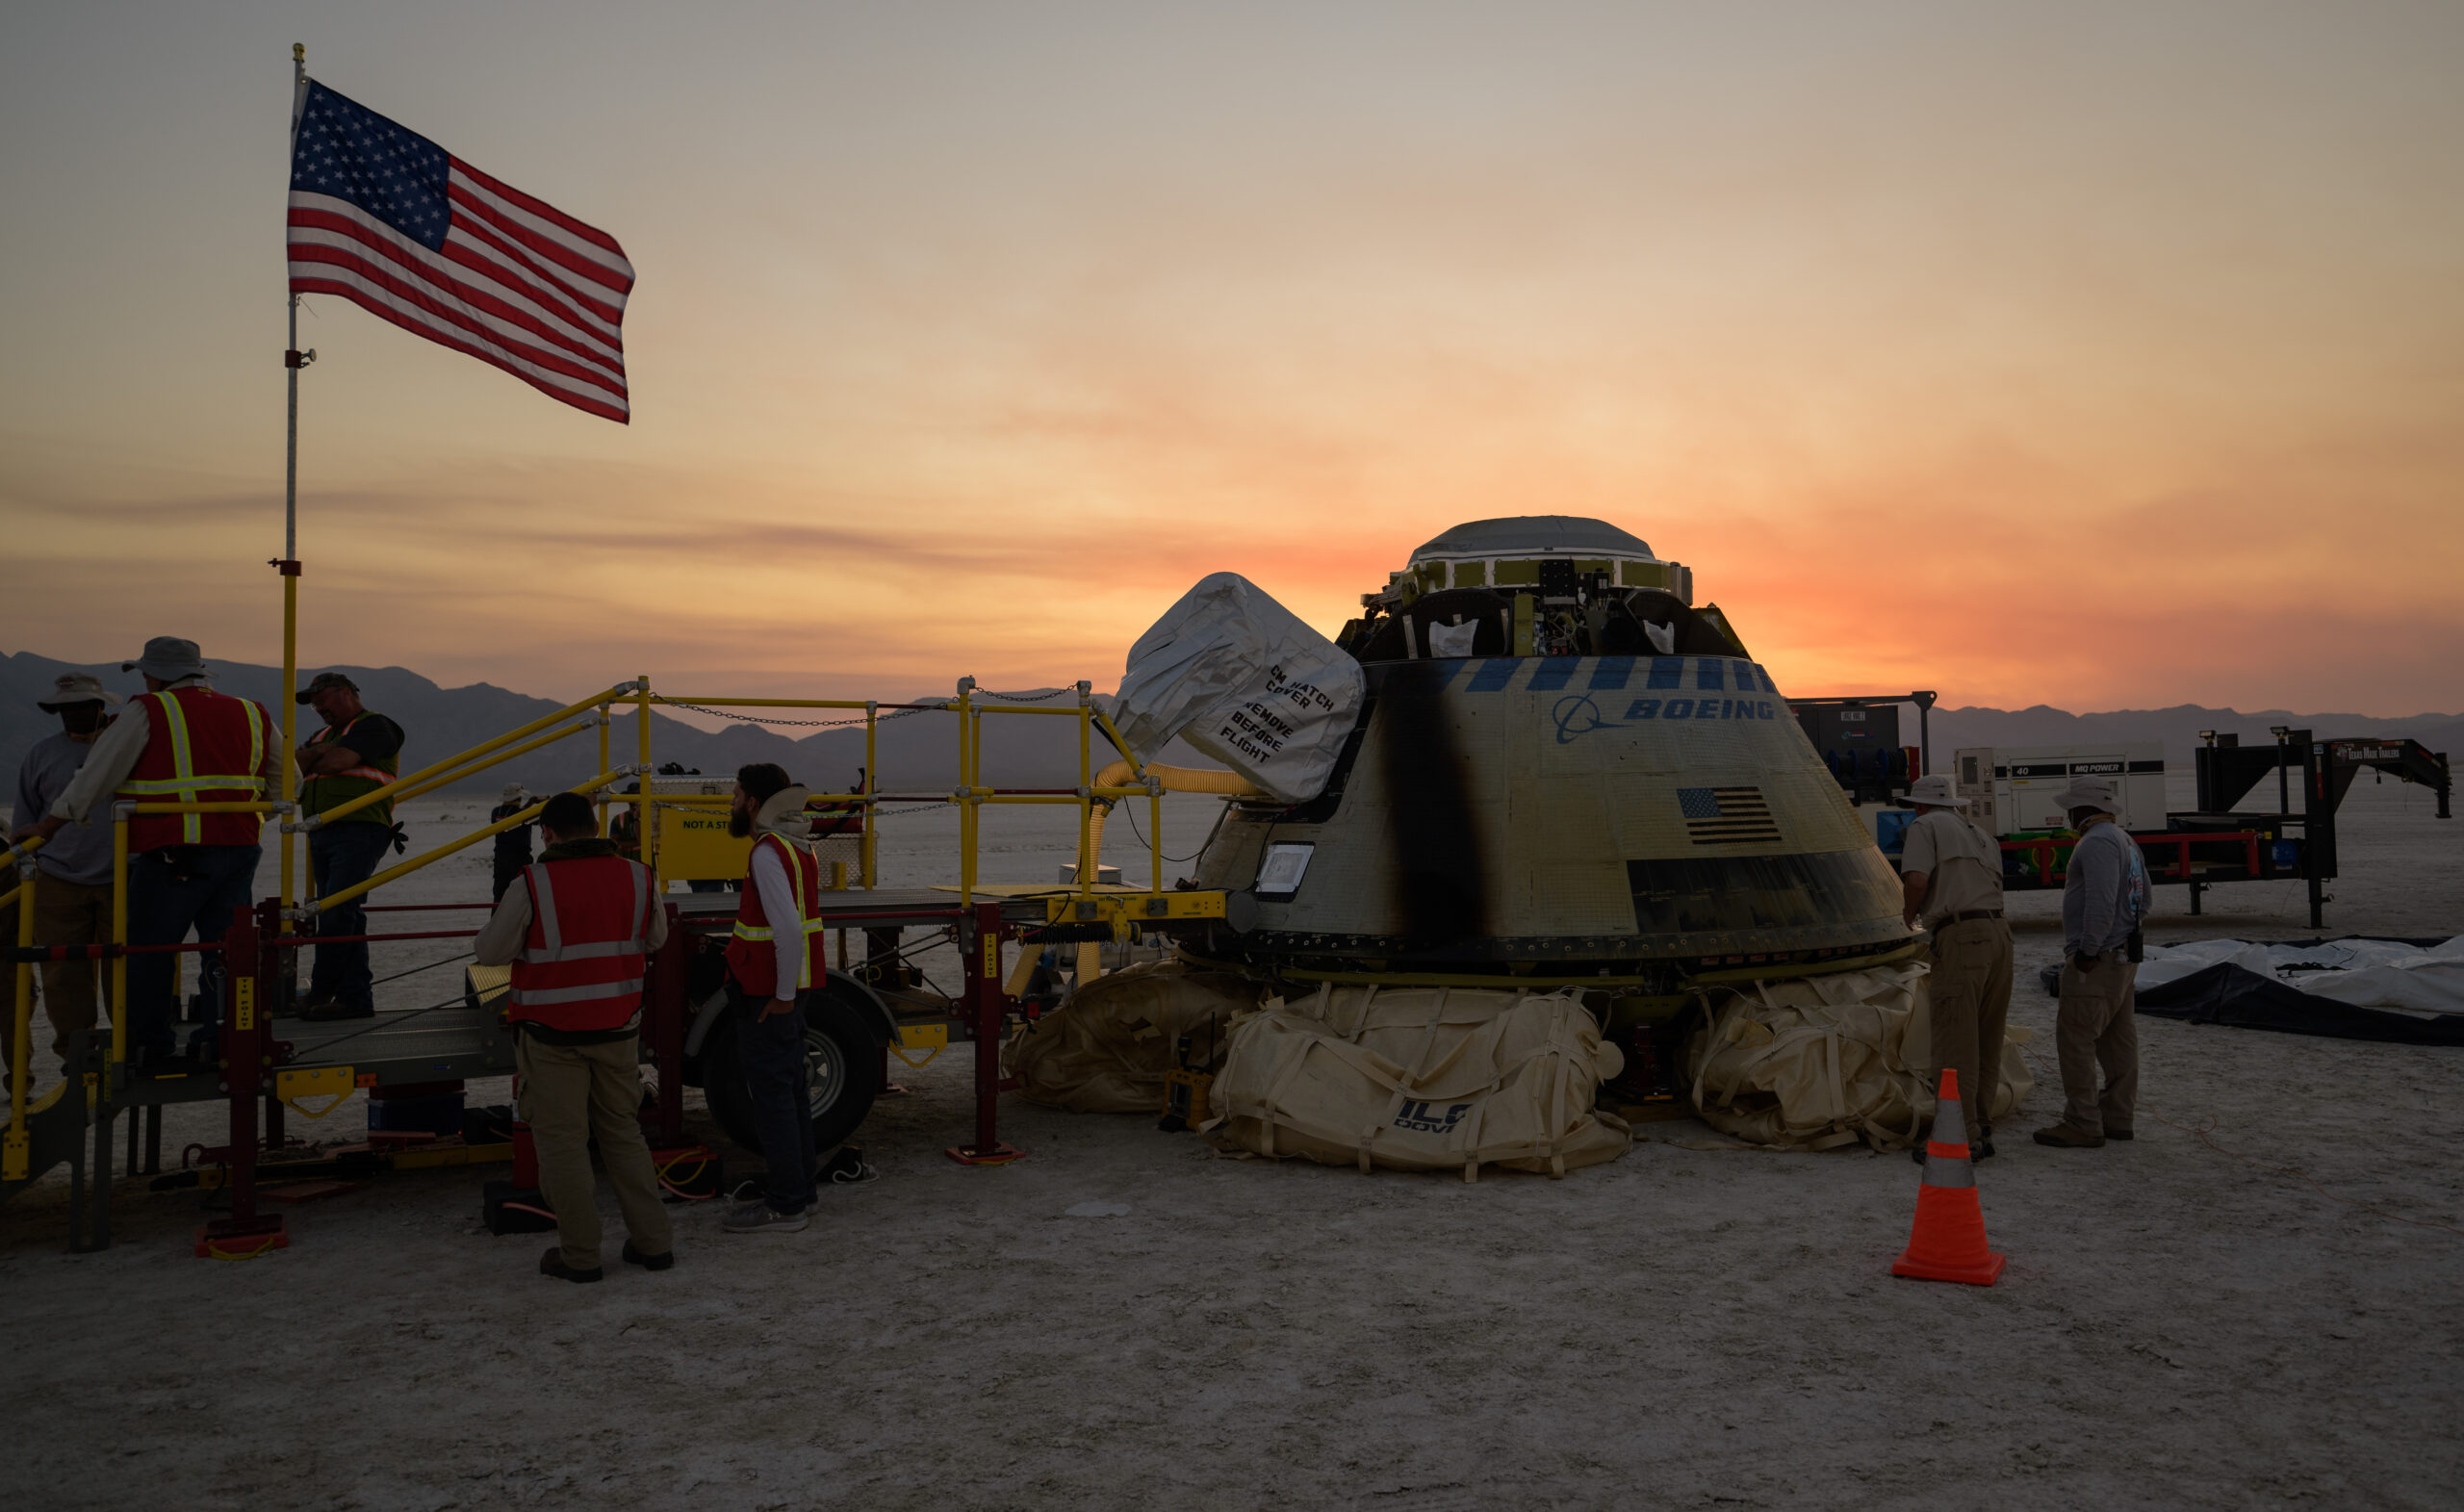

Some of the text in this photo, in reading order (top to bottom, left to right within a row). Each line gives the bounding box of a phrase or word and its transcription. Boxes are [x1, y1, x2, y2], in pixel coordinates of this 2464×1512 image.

[1266, 679, 1311, 709] COVER
[1270, 664, 1334, 712] CM HATCH
[1623, 699, 1775, 720] BOEING
[1231, 710, 1283, 753] BEFORE
[1220, 726, 1270, 763] FLIGHT
[2016, 766, 2029, 776] 40
[2090, 763, 2119, 773] POWER
[683, 820, 703, 829] NOT
[716, 820, 729, 829] ST
